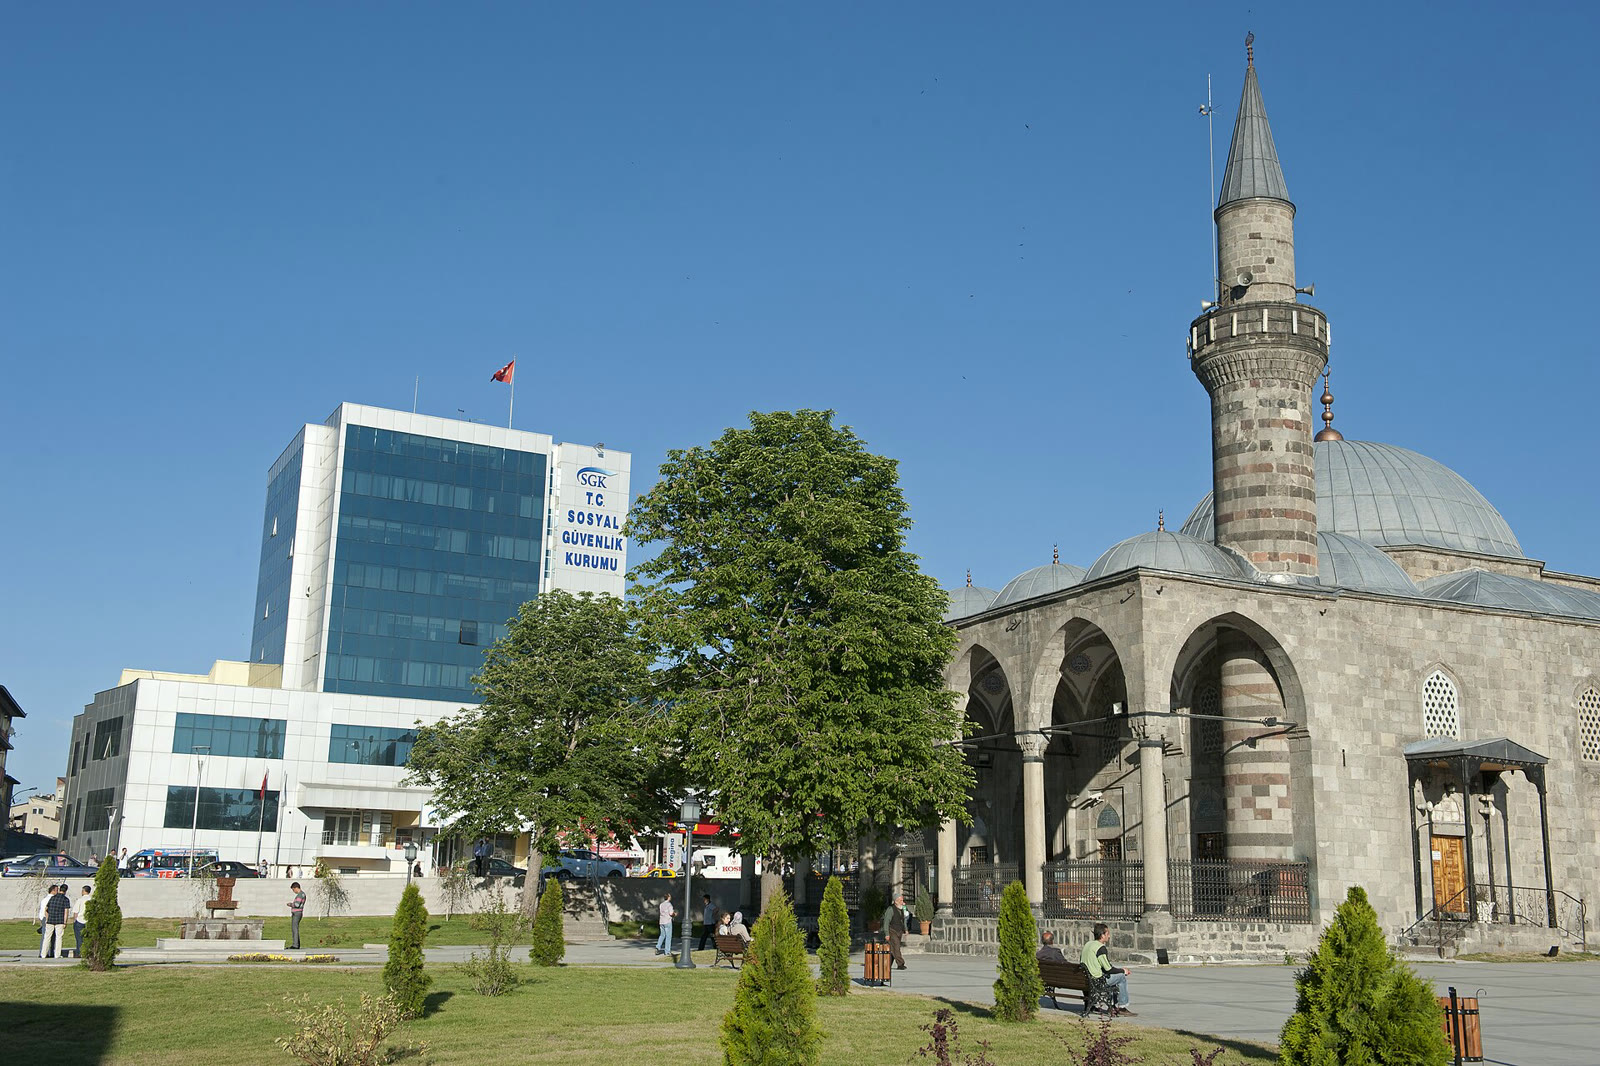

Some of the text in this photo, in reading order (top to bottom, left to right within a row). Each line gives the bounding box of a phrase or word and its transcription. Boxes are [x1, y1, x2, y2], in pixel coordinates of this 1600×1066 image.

[581, 473, 607, 489] SGK
[567, 509, 619, 530] SOSYAL
[562, 529, 623, 551] GÜVENLİK
[565, 551, 618, 572] KURUMU
